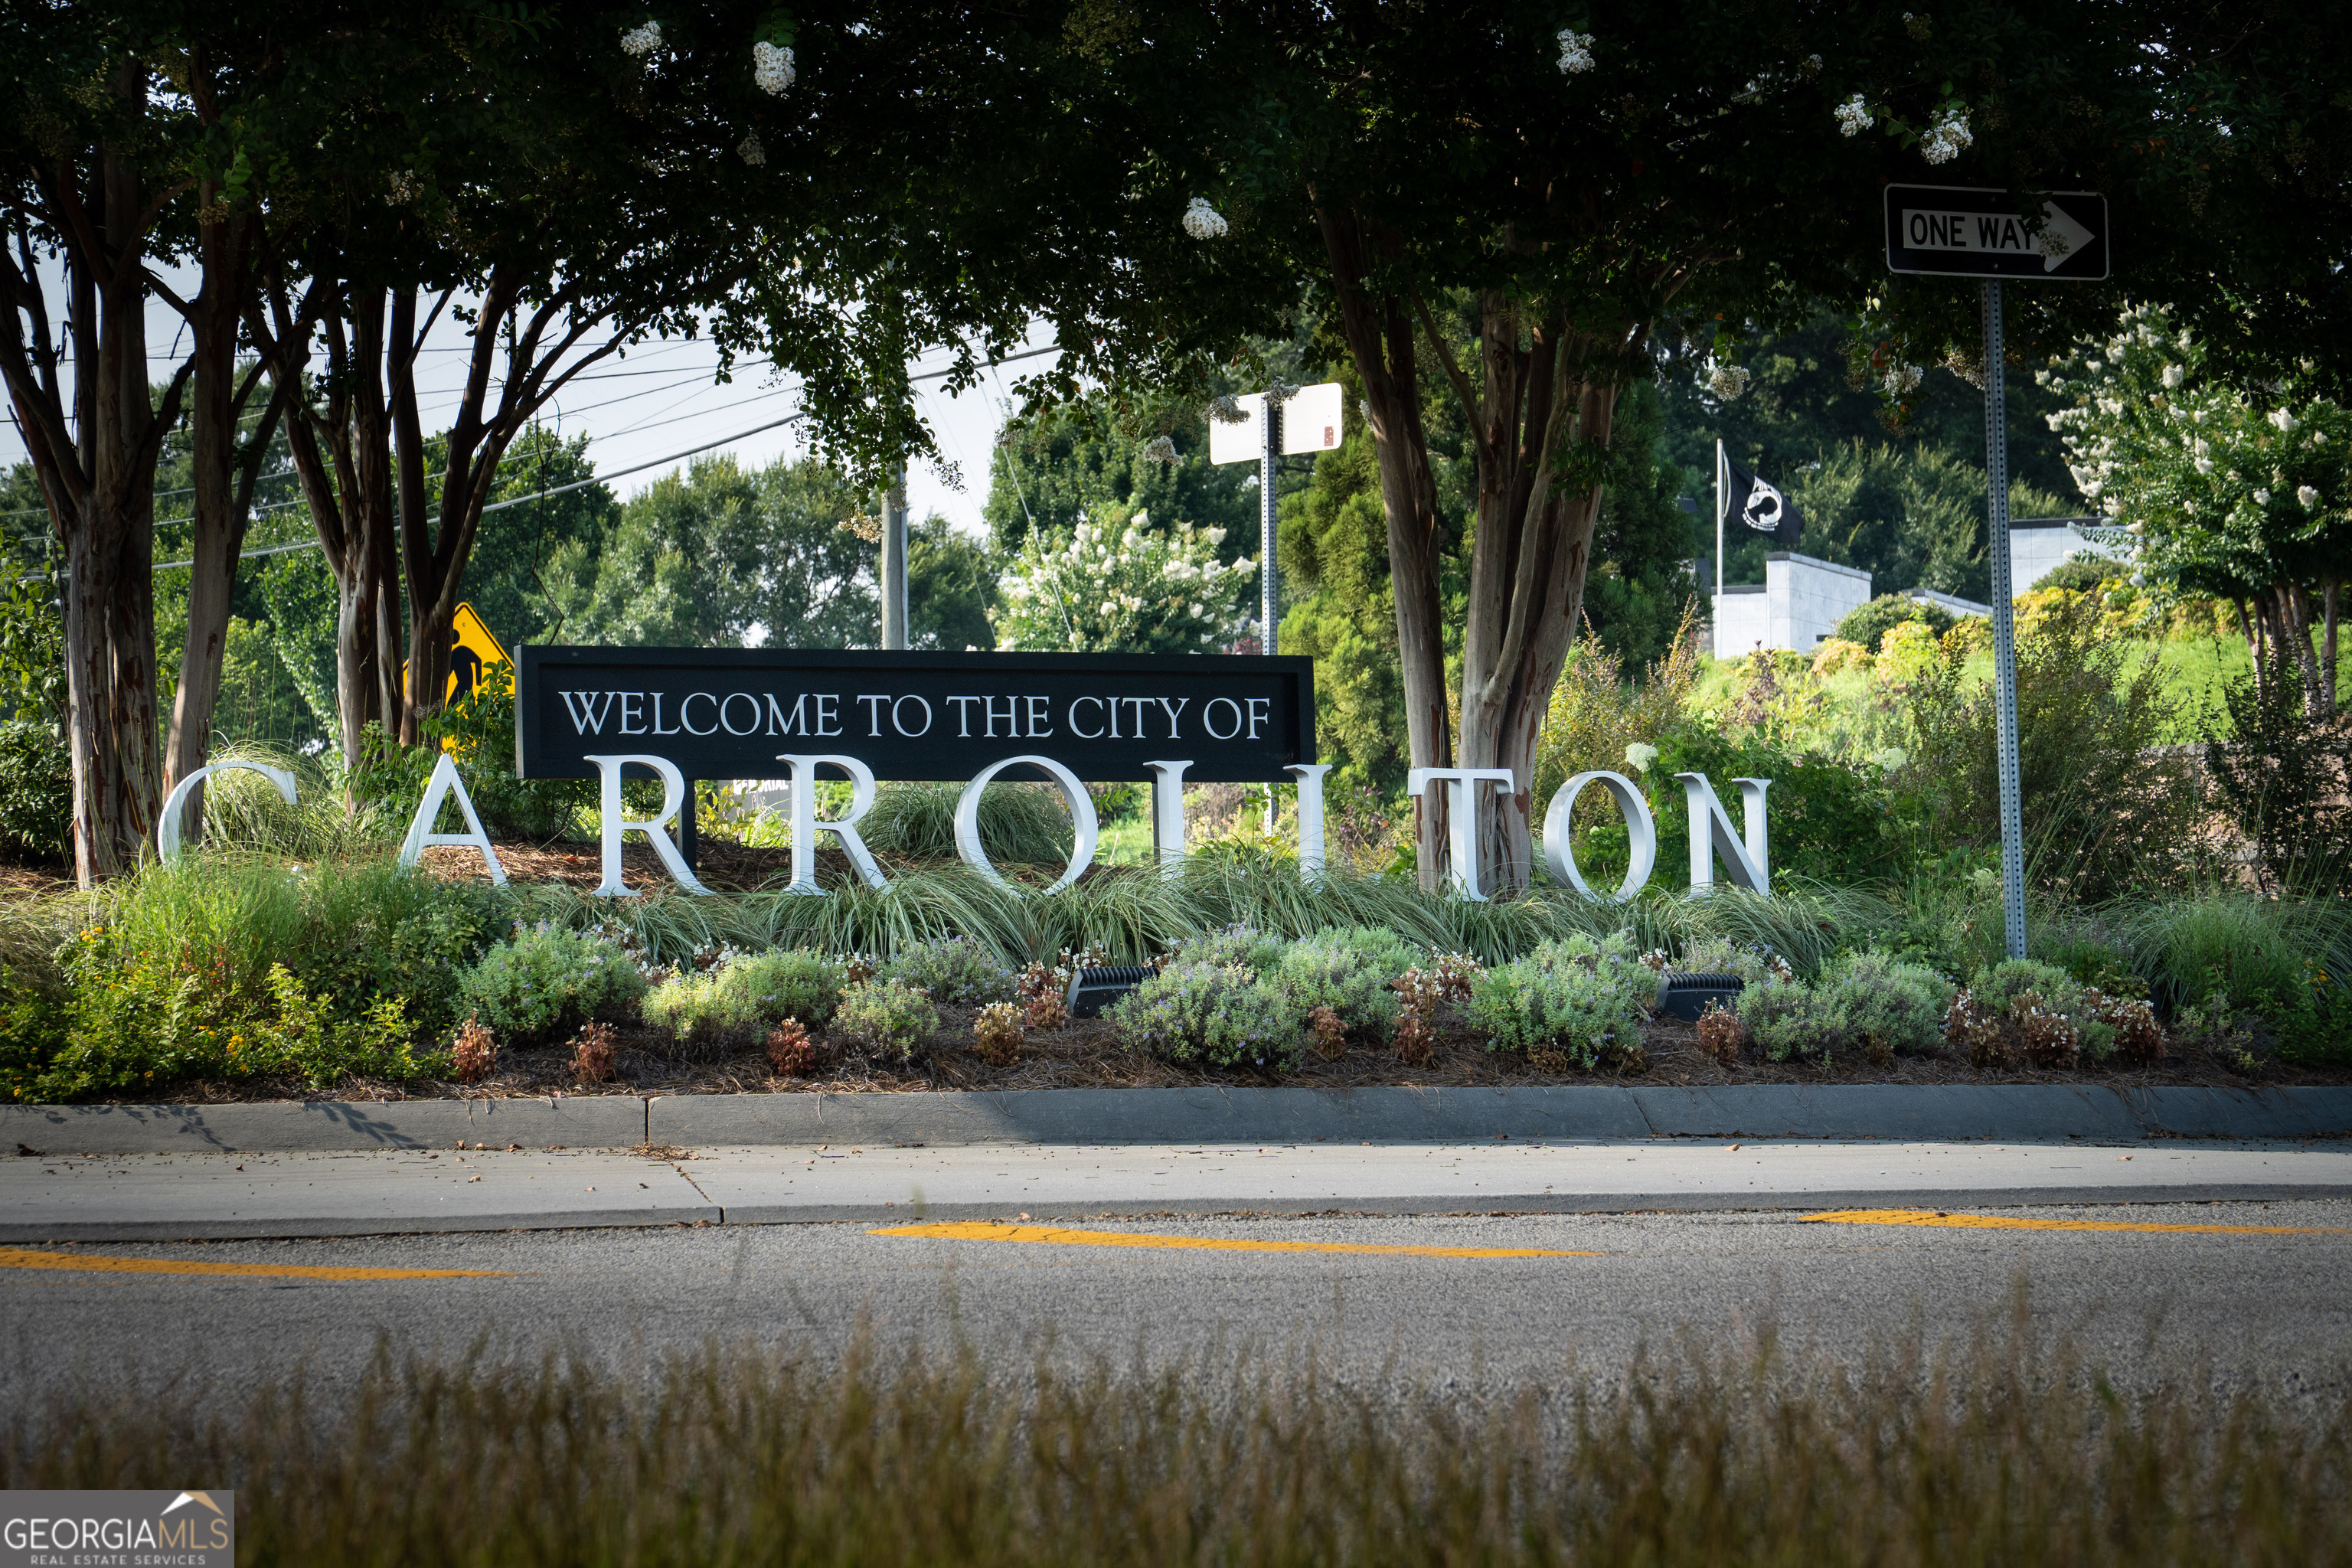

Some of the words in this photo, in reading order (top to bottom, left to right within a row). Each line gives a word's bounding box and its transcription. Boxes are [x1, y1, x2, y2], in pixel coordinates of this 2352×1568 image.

[1909, 213, 1967, 247] ONE
[1978, 217, 2035, 250] WAY
[558, 691, 843, 737] WELCOME
[856, 694, 932, 737] TO
[946, 695, 1054, 737] THE
[1068, 696, 1190, 739] CITY
[1203, 697, 1270, 740] OF
